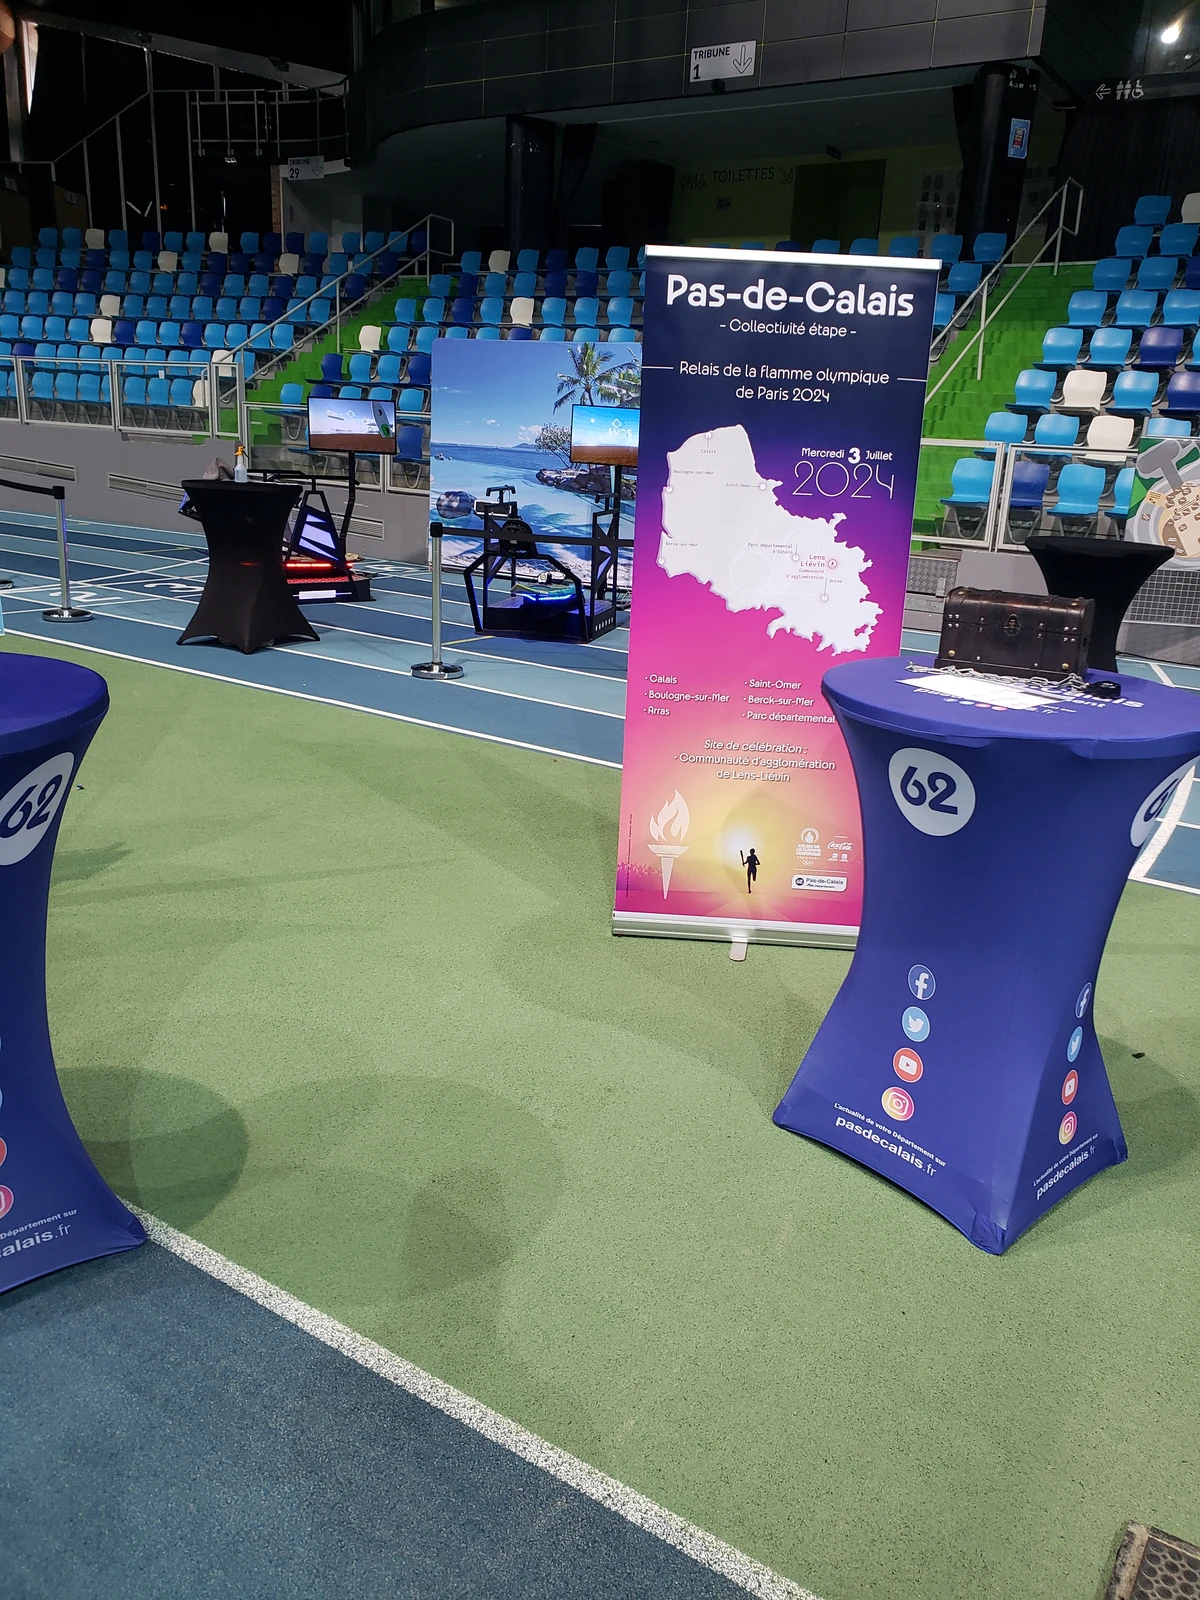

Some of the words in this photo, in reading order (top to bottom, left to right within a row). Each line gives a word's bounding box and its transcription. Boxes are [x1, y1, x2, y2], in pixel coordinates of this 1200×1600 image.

[693, 46, 731, 60] TRIBUNE
[693, 64, 700, 80] 1
[289, 167, 300, 179] 29
[711, 166, 775, 183] TOILETTES
[666, 274, 914, 317] Pas-de-Calais
[729, 318, 806, 336] Collectivité
[808, 322, 847, 339] étape
[679, 360, 720, 377] Relais
[723, 363, 742, 377] de
[744, 364, 757, 378] la
[760, 365, 813, 381] flamme
[816, 367, 890, 386] olympique
[735, 385, 754, 399] de
[757, 386, 789, 401] Paris
[792, 388, 830, 403] 2024
[801, 447, 845, 459] Mercredi
[847, 447, 861, 464] 3
[865, 450, 893, 461] Juillet
[792, 460, 895, 499] 2024
[800, 560, 825, 568] Liévin
[650, 673, 678, 684] Calais
[749, 679, 802, 690] Saint-Omer
[648, 689, 730, 703] Boulogne-sur-Mer
[748, 694, 815, 707] Berck-sur-Mer
[647, 706, 671, 716] Arras
[747, 711, 767, 721] Parc
[768, 711, 836, 724] départemental
[703, 739, 724, 750] Site
[725, 740, 740, 750] de
[741, 741, 802, 754] célébration
[679, 752, 749, 765] Communauté
[751, 756, 836, 770] d'agglomération
[716, 768, 730, 779] de
[731, 769, 791, 782] Lens-Liévin
[900, 765, 958, 815] 62
[0, 773, 63, 838] 62
[833, 1102, 866, 1121] L'actualité
[865, 1117, 875, 1126] de
[875, 1122, 892, 1135] votre
[892, 1131, 935, 1160] Département
[935, 1156, 947, 1167] sur
[835, 1116, 937, 1177] pasdecalais.fr
[1036, 1144, 1096, 1201] pasdecalais.fr
[0, 1213, 62, 1240] Département
[62, 1208, 78, 1218] sur
